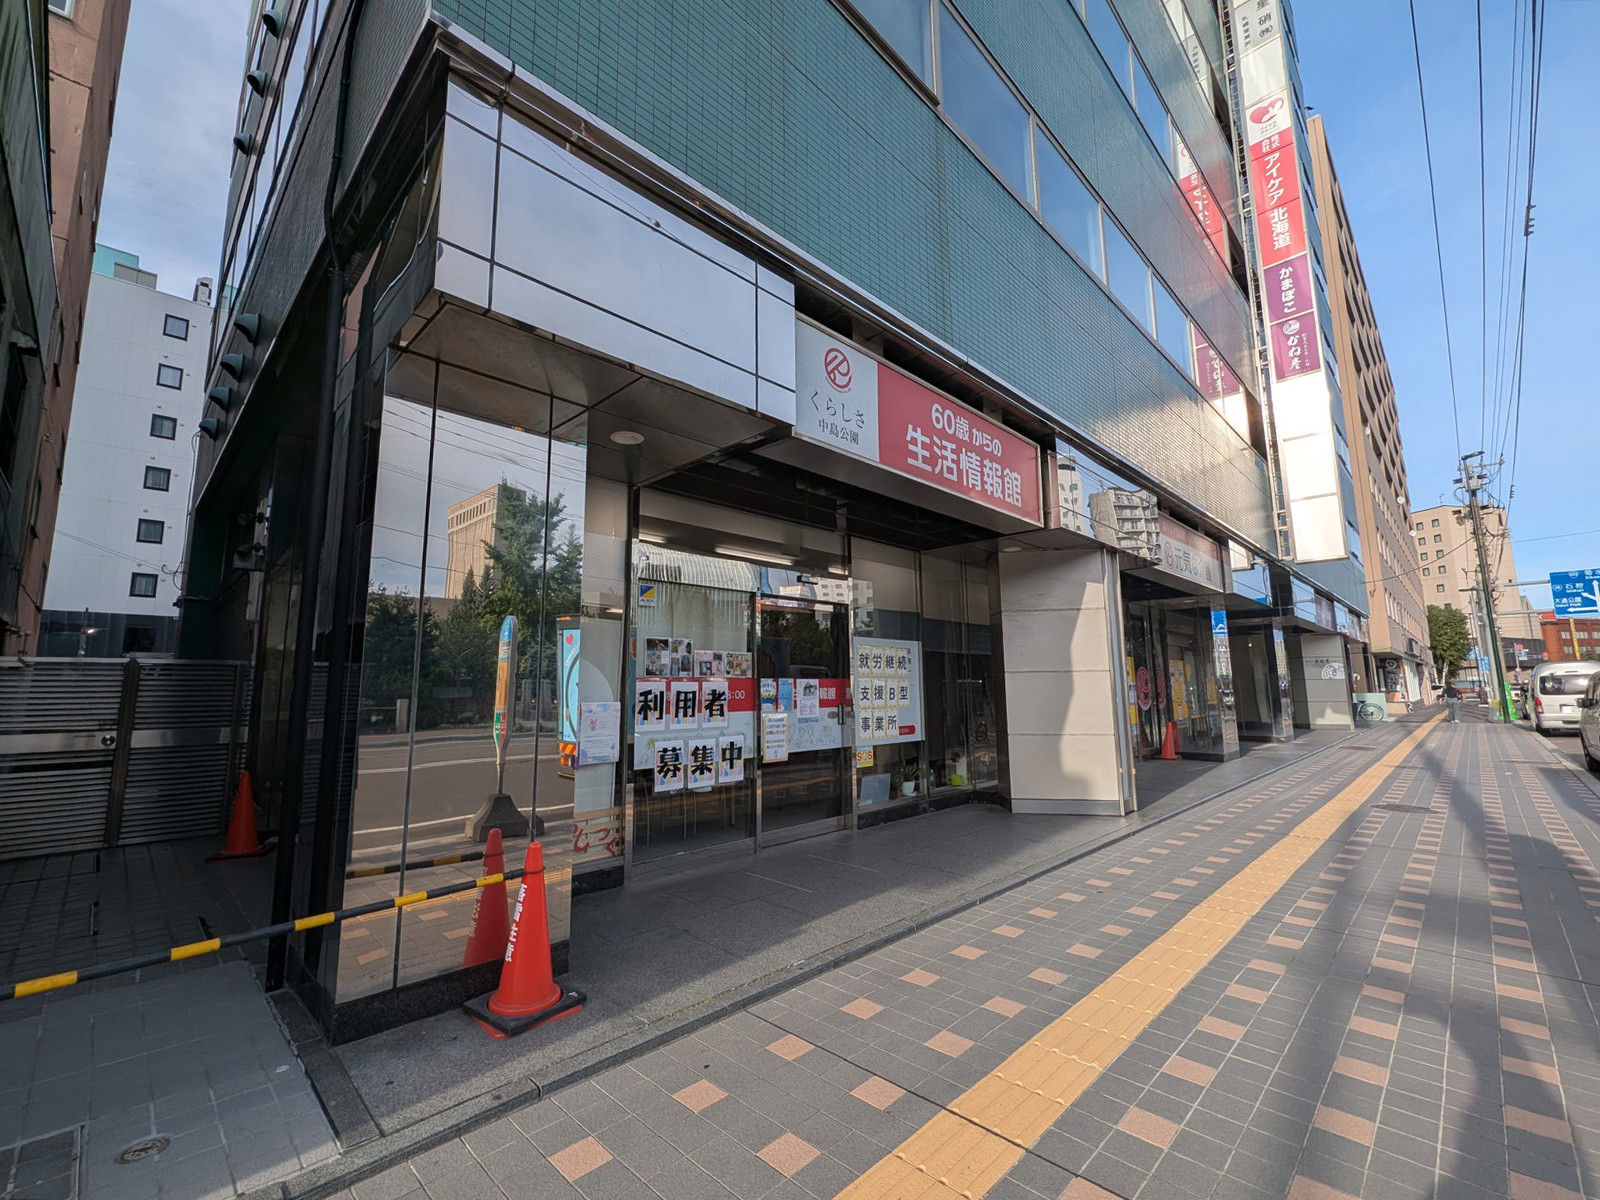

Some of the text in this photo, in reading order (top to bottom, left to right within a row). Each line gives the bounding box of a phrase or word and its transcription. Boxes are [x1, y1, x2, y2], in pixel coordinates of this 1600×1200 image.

[1279, 266, 1297, 314] かまぼこ
[810, 391, 865, 430] くらしさ
[818, 418, 859, 446] 中島公園
[905, 424, 1022, 508] 生活情報館
[858, 651, 908, 670] 就労継続
[637, 688, 728, 721] 利用者
[860, 685, 909, 702] 支援B型
[860, 715, 897, 733] 事業所
[657, 742, 742, 778] 募集中
